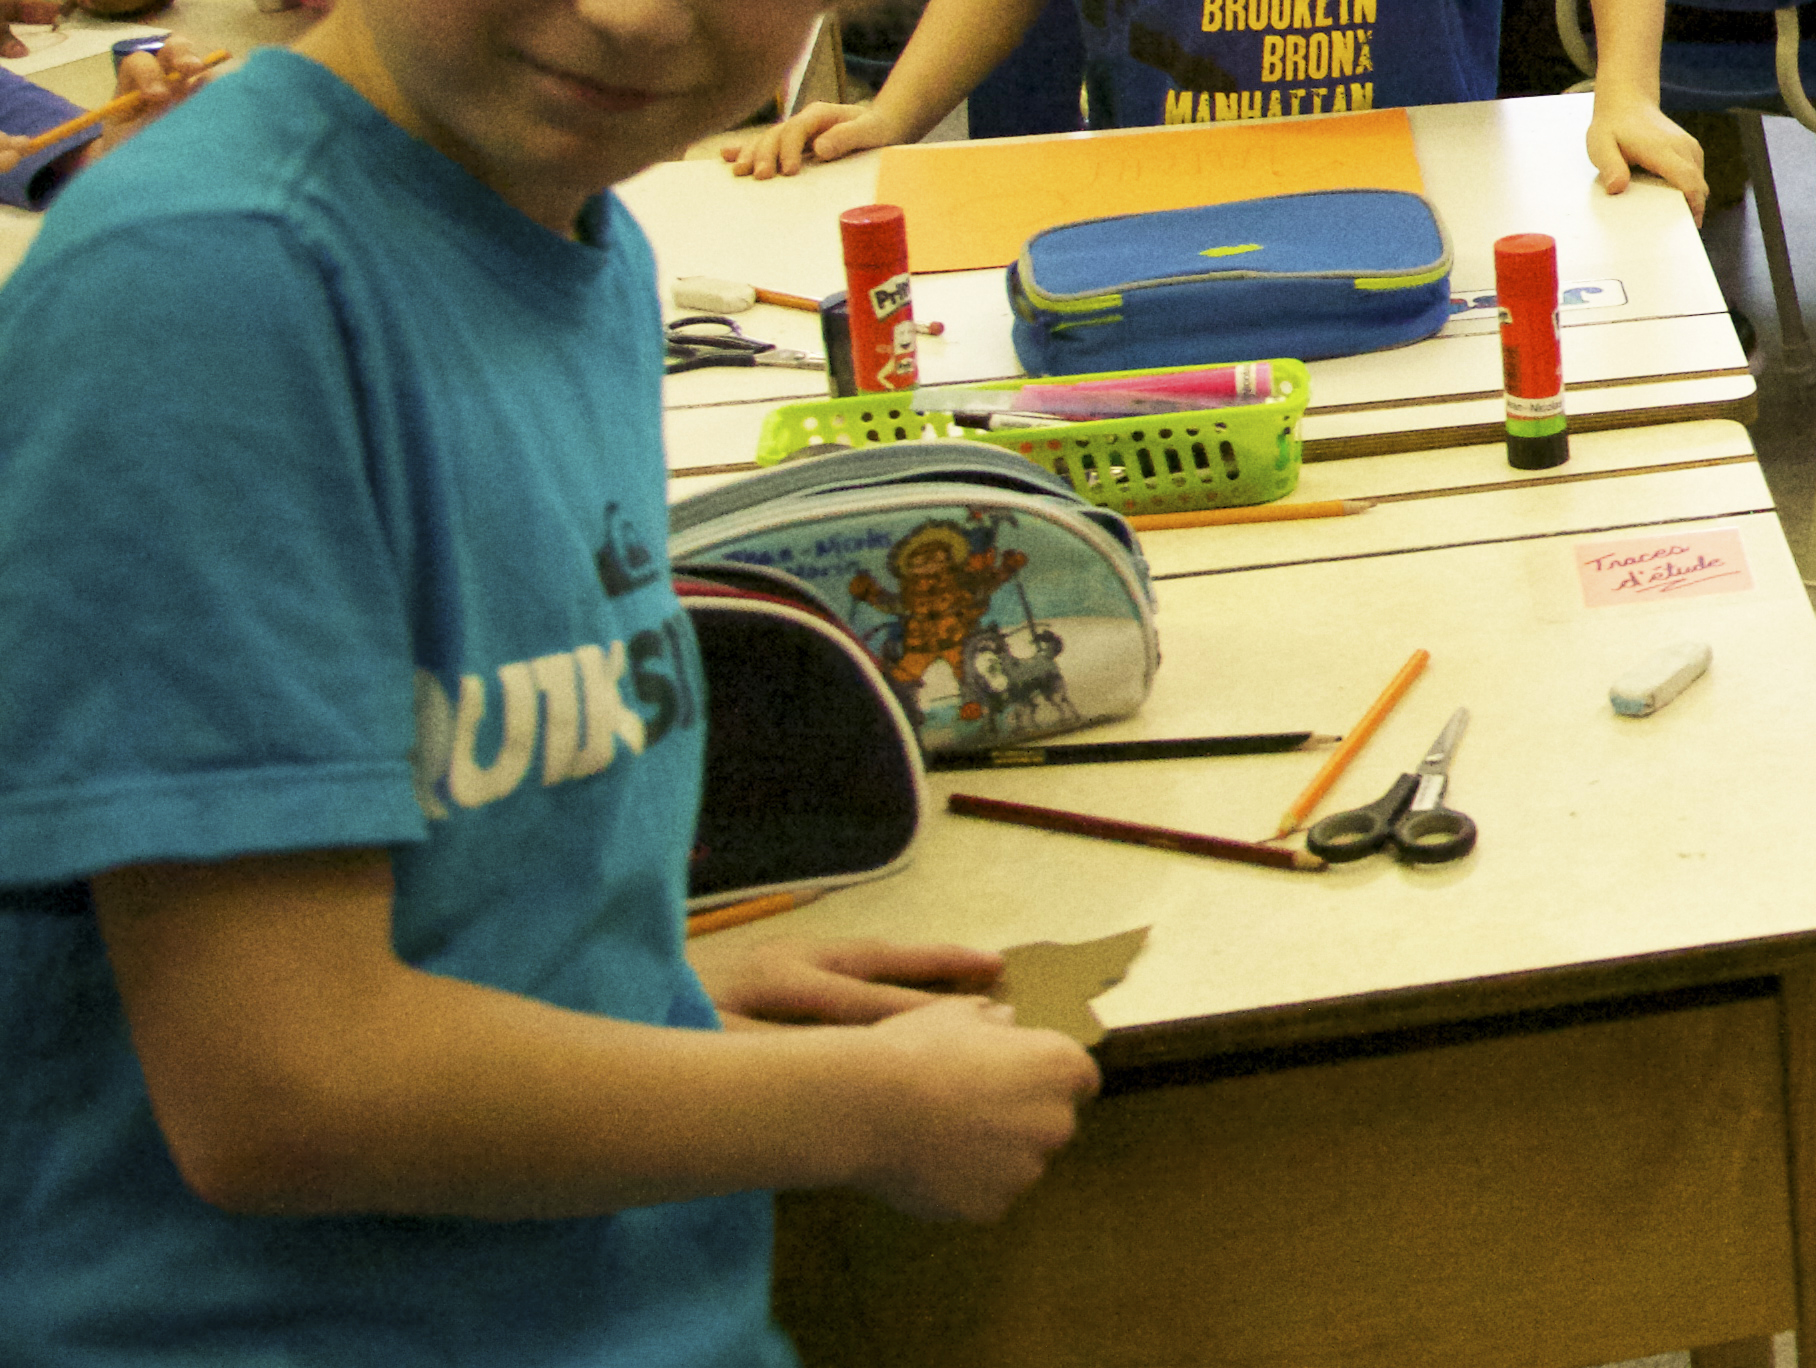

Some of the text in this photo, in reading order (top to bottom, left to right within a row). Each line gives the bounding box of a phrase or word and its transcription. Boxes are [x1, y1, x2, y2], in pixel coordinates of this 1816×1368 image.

[1261, 30, 1374, 82] BRONX
[1164, 82, 1374, 126] MANHATTAN
[1584, 544, 1691, 572] Traces
[1611, 555, 1727, 592] d'étude
